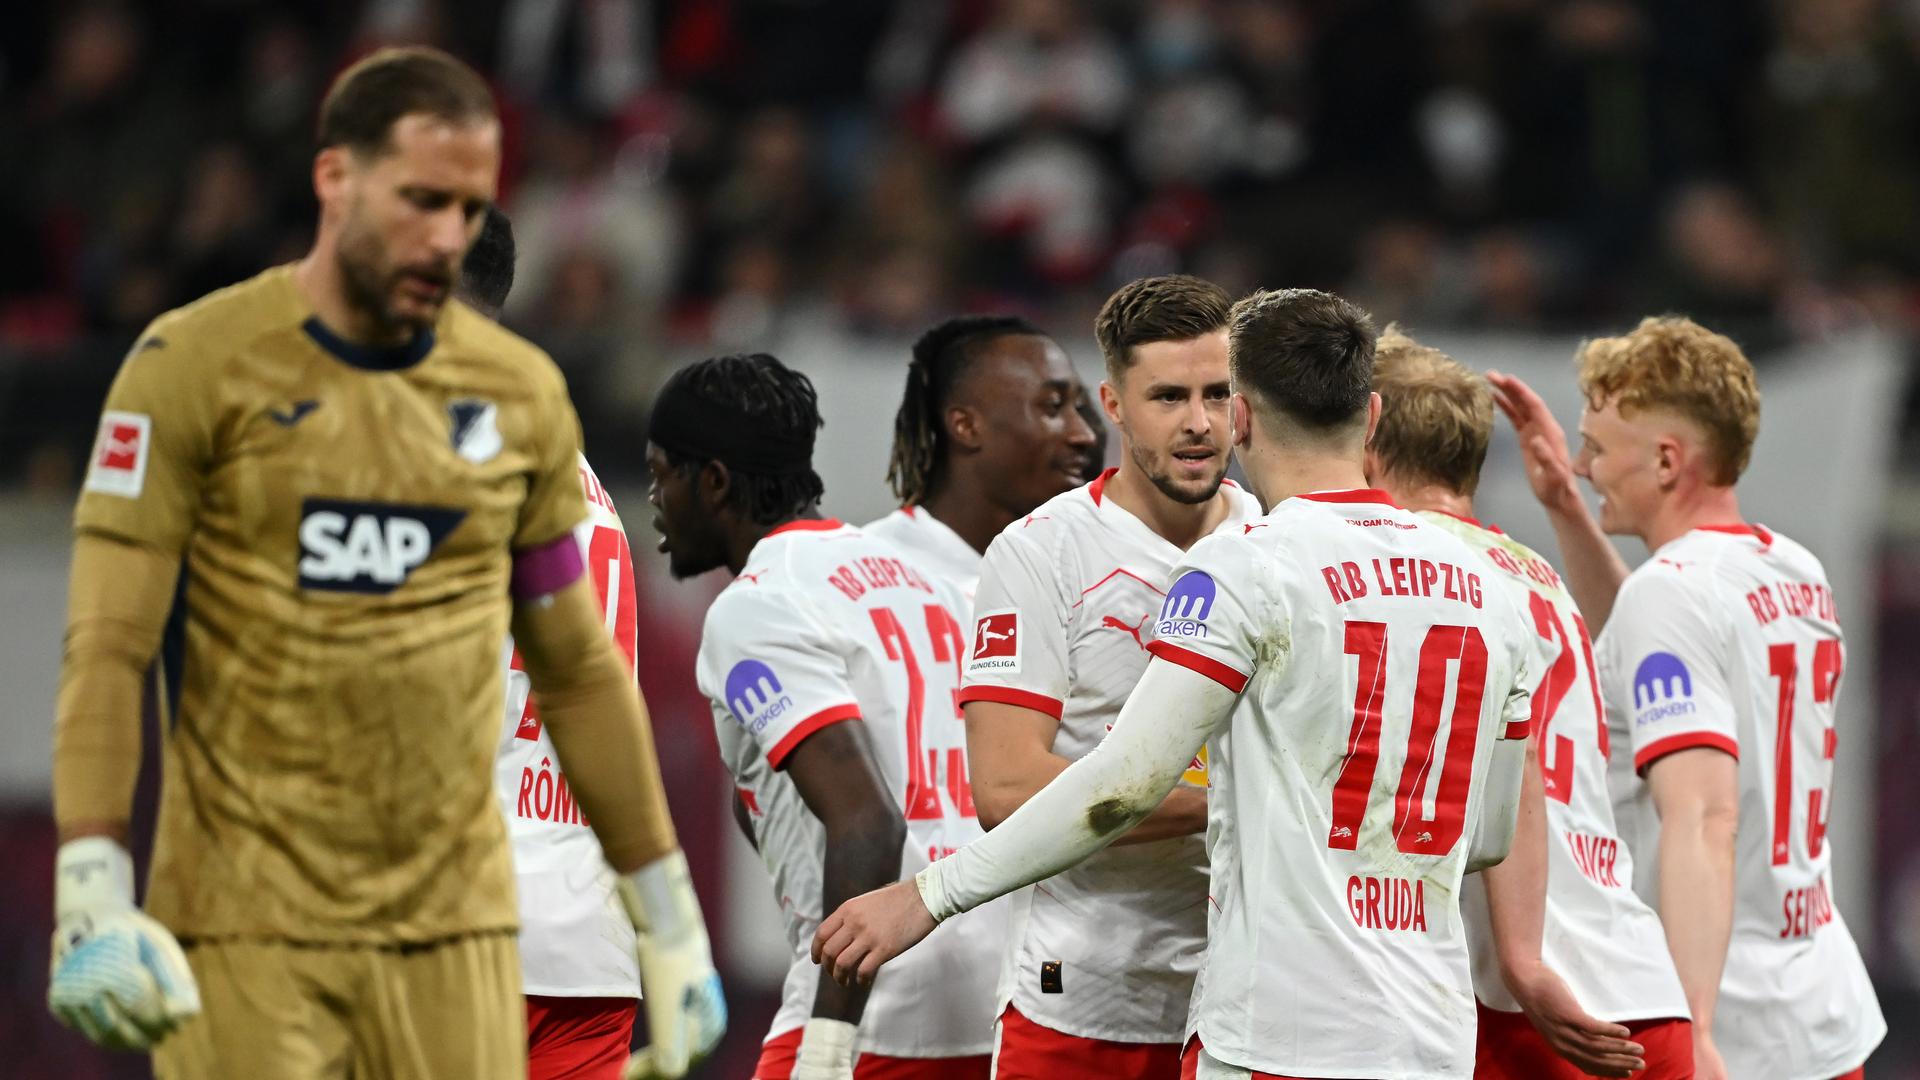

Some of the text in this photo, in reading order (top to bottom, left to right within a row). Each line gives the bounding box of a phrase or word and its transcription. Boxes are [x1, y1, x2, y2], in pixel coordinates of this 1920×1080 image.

[299, 511, 431, 584] SAP
[1363, 519, 1382, 528] CAN
[1383, 518, 1394, 527] DO
[827, 565, 866, 602] RB
[1320, 557, 1483, 610] RB LEIPZIG
[1746, 585, 1779, 626] RB
[970, 660, 1016, 671] BUNDESLIGA
[1328, 619, 1489, 857] 10
[1767, 638, 1843, 867] 13
[1346, 875, 1428, 933] GRUDA
